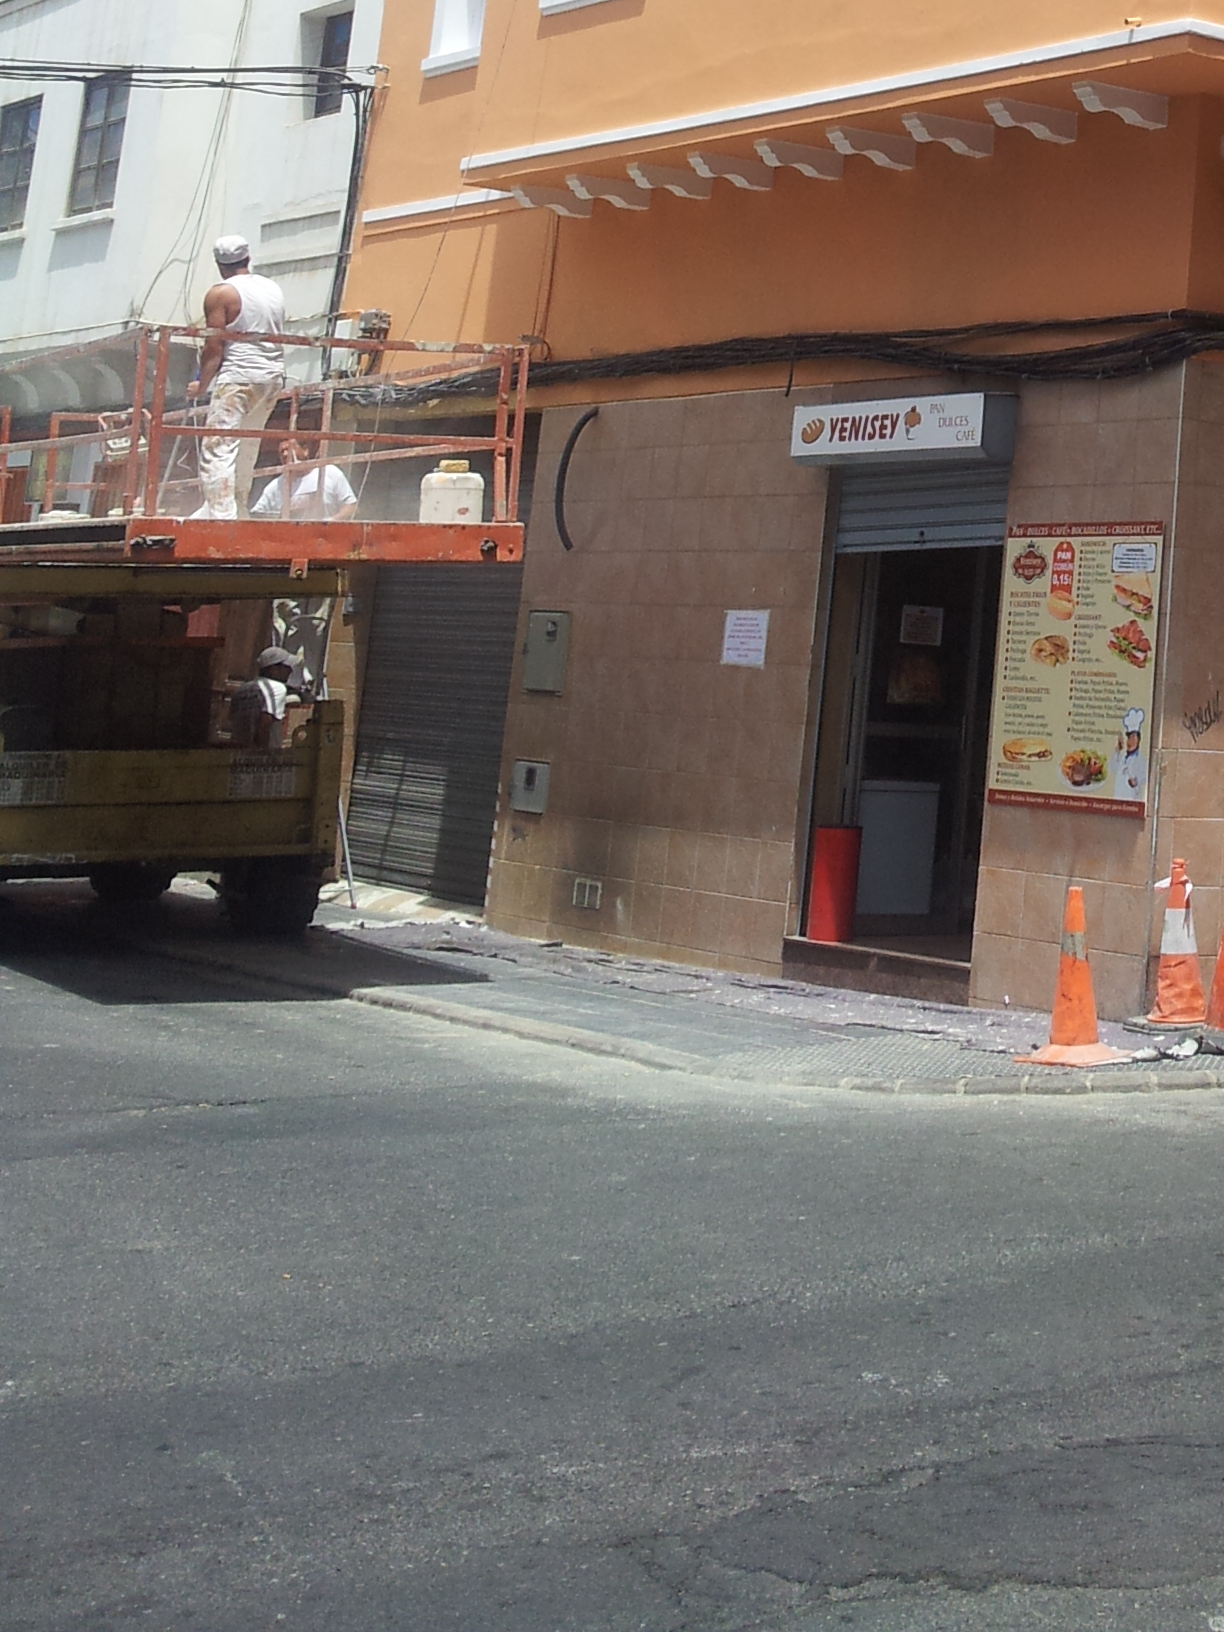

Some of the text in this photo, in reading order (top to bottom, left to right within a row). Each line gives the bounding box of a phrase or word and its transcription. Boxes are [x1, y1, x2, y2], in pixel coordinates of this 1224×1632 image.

[930, 403, 946, 414] PAN
[828, 412, 900, 443] YENISEY
[938, 415, 969, 428] DULCES
[955, 426, 977, 442] CAFÉ
[1057, 551, 1072, 560] PAN
